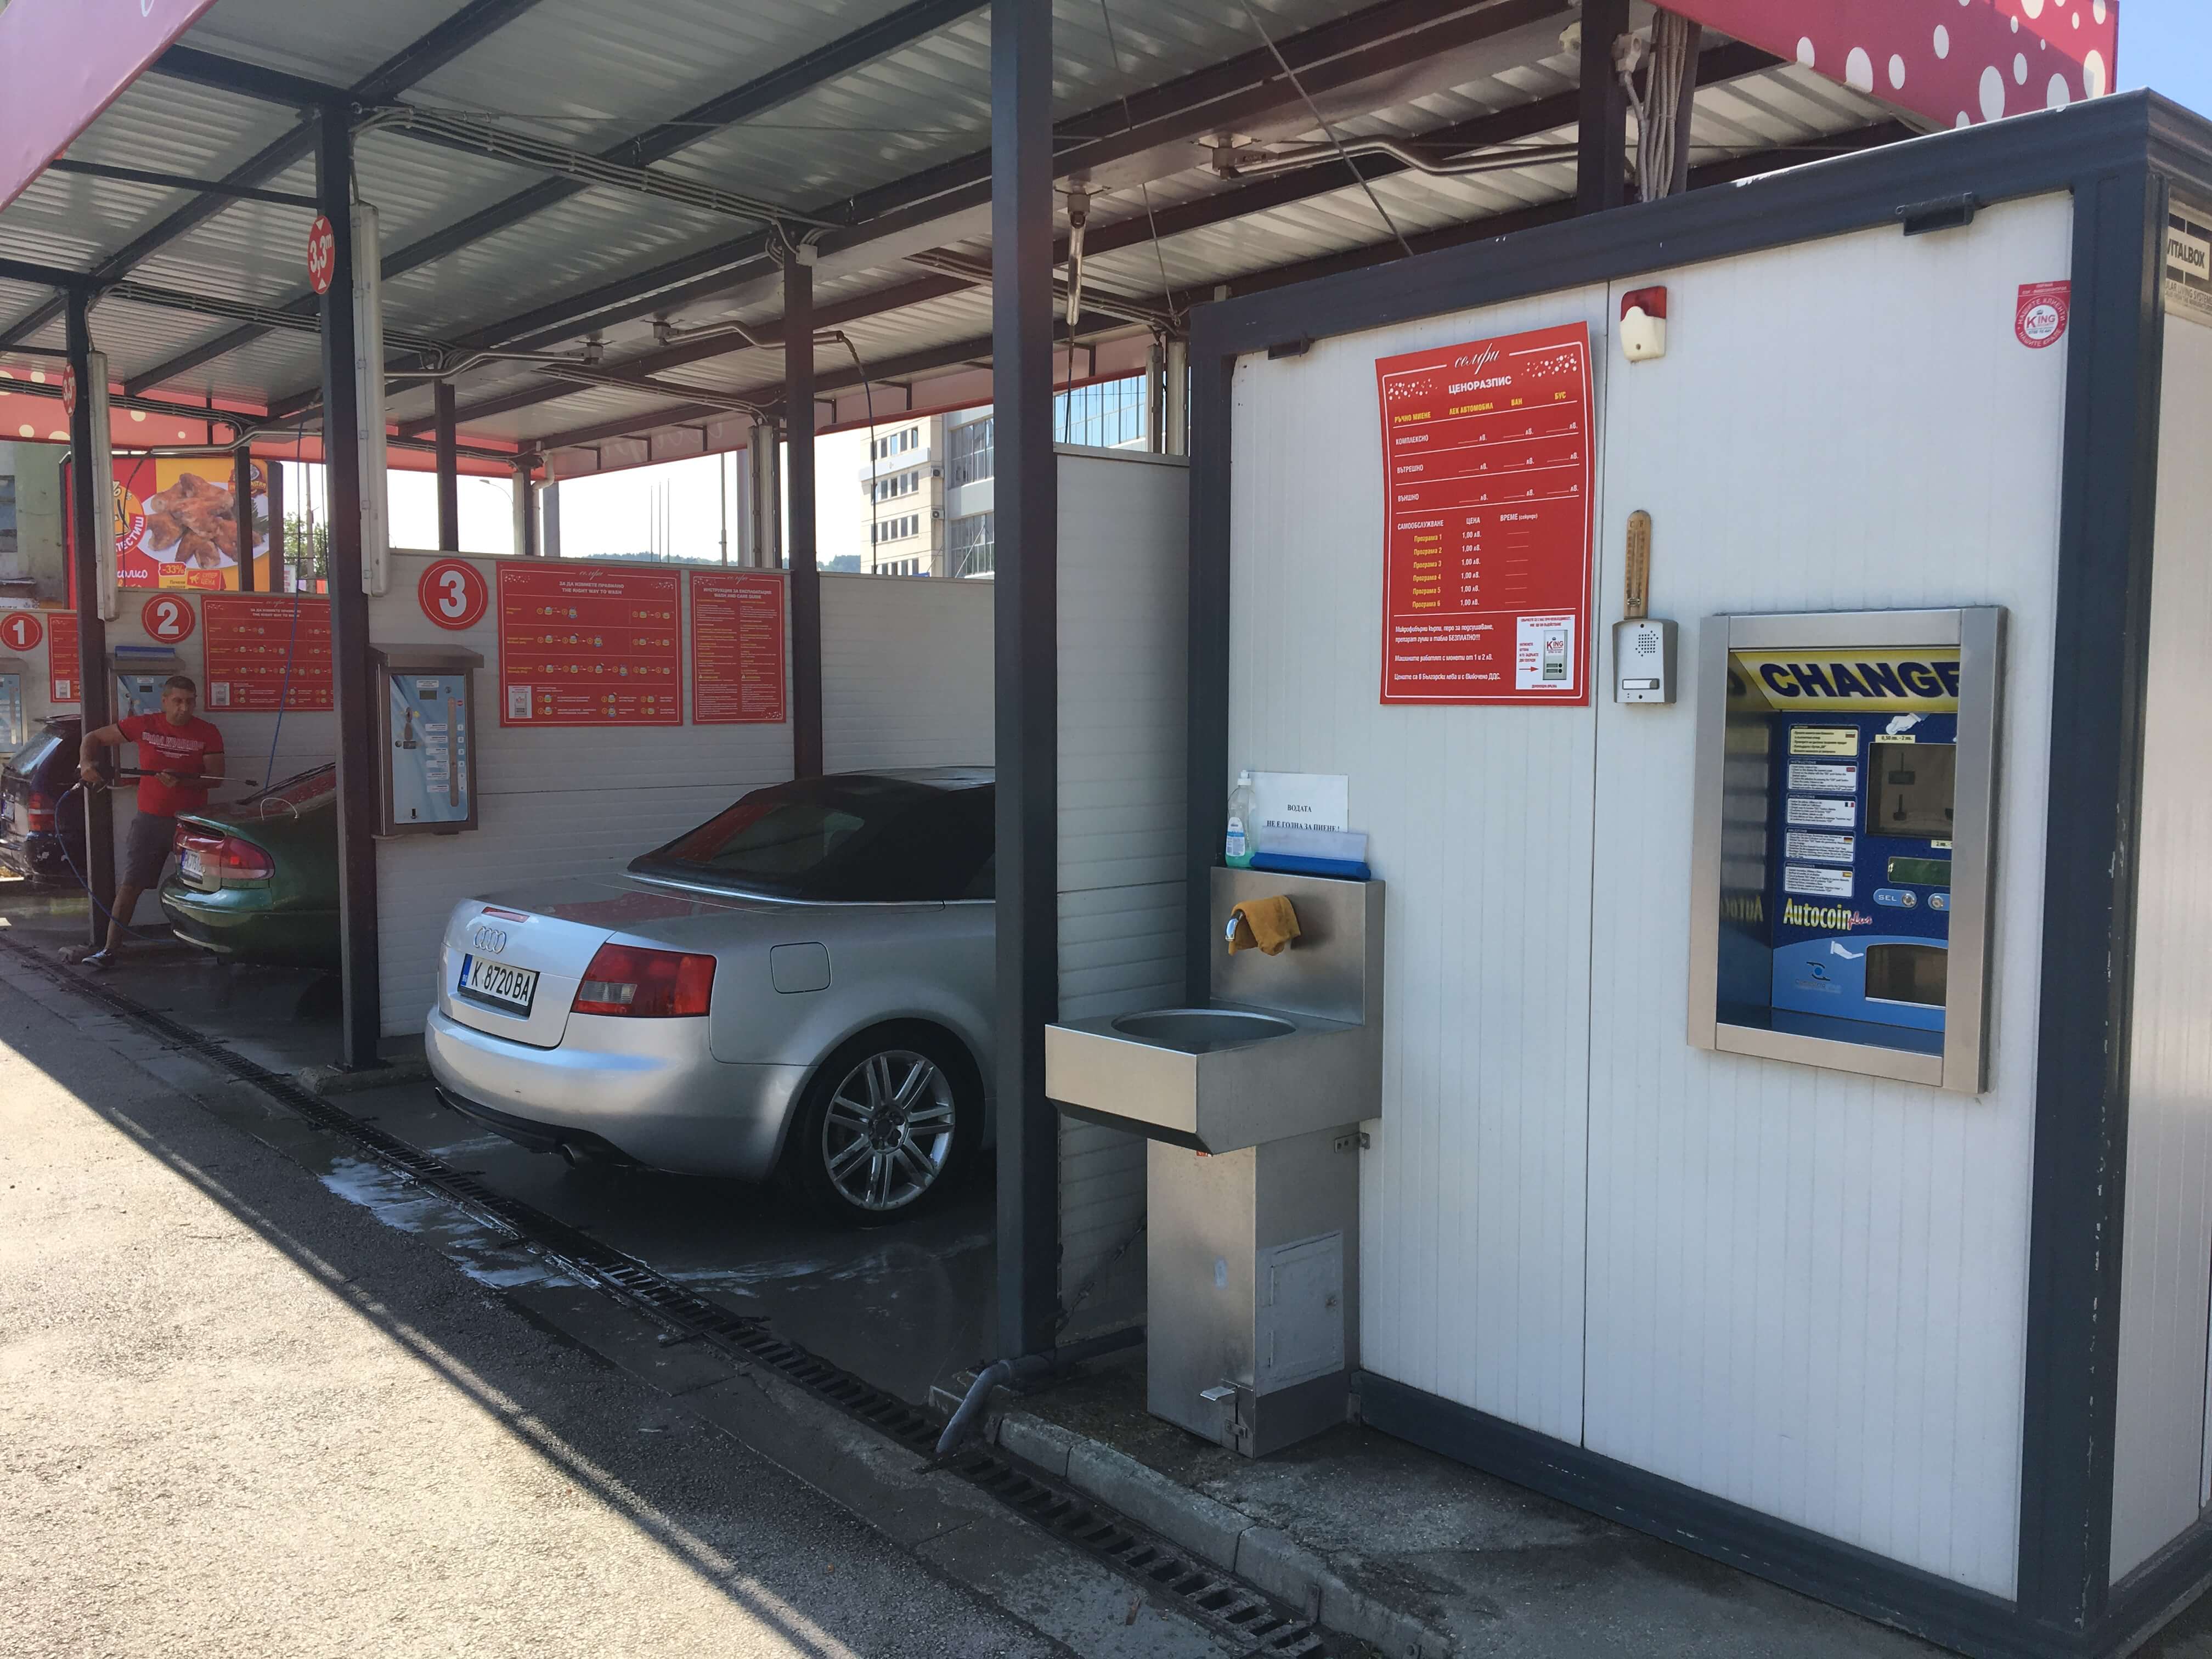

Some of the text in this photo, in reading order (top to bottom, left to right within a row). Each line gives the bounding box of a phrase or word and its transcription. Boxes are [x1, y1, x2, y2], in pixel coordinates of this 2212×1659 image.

[2026, 314, 2056, 329] KING
[1448, 376, 1512, 395] ЦЕНОРАЗПИС
[1395, 391, 1566, 423] РЪЧНО МИЕНЕ ЛЕК АВТОМОБИЛ ВАН БУС
[1395, 435, 1429, 445] КОМПЛЕКСНО
[1397, 464, 1424, 474] ВЪТРЕШНО
[1397, 493, 1419, 502] ВЪНШНО
[1397, 520, 1444, 530] САМООБСЛУЖВАНЕ
[1466, 517, 1480, 525] ЦЕНА
[1500, 514, 1518, 522] ВРЕМЕ
[162, 565, 185, 574] -33%
[439, 570, 467, 618] 3
[1413, 588, 1436, 596] Програма
[156, 602, 179, 634] 2
[13, 620, 25, 645] 1
[1547, 641, 1564, 650] KING
[1488, 673, 1501, 681] ДДС.
[1759, 662, 1960, 698] CHANGE
[1287, 804, 1312, 812] ВОДАТА
[1783, 898, 1852, 930] Autocoin
